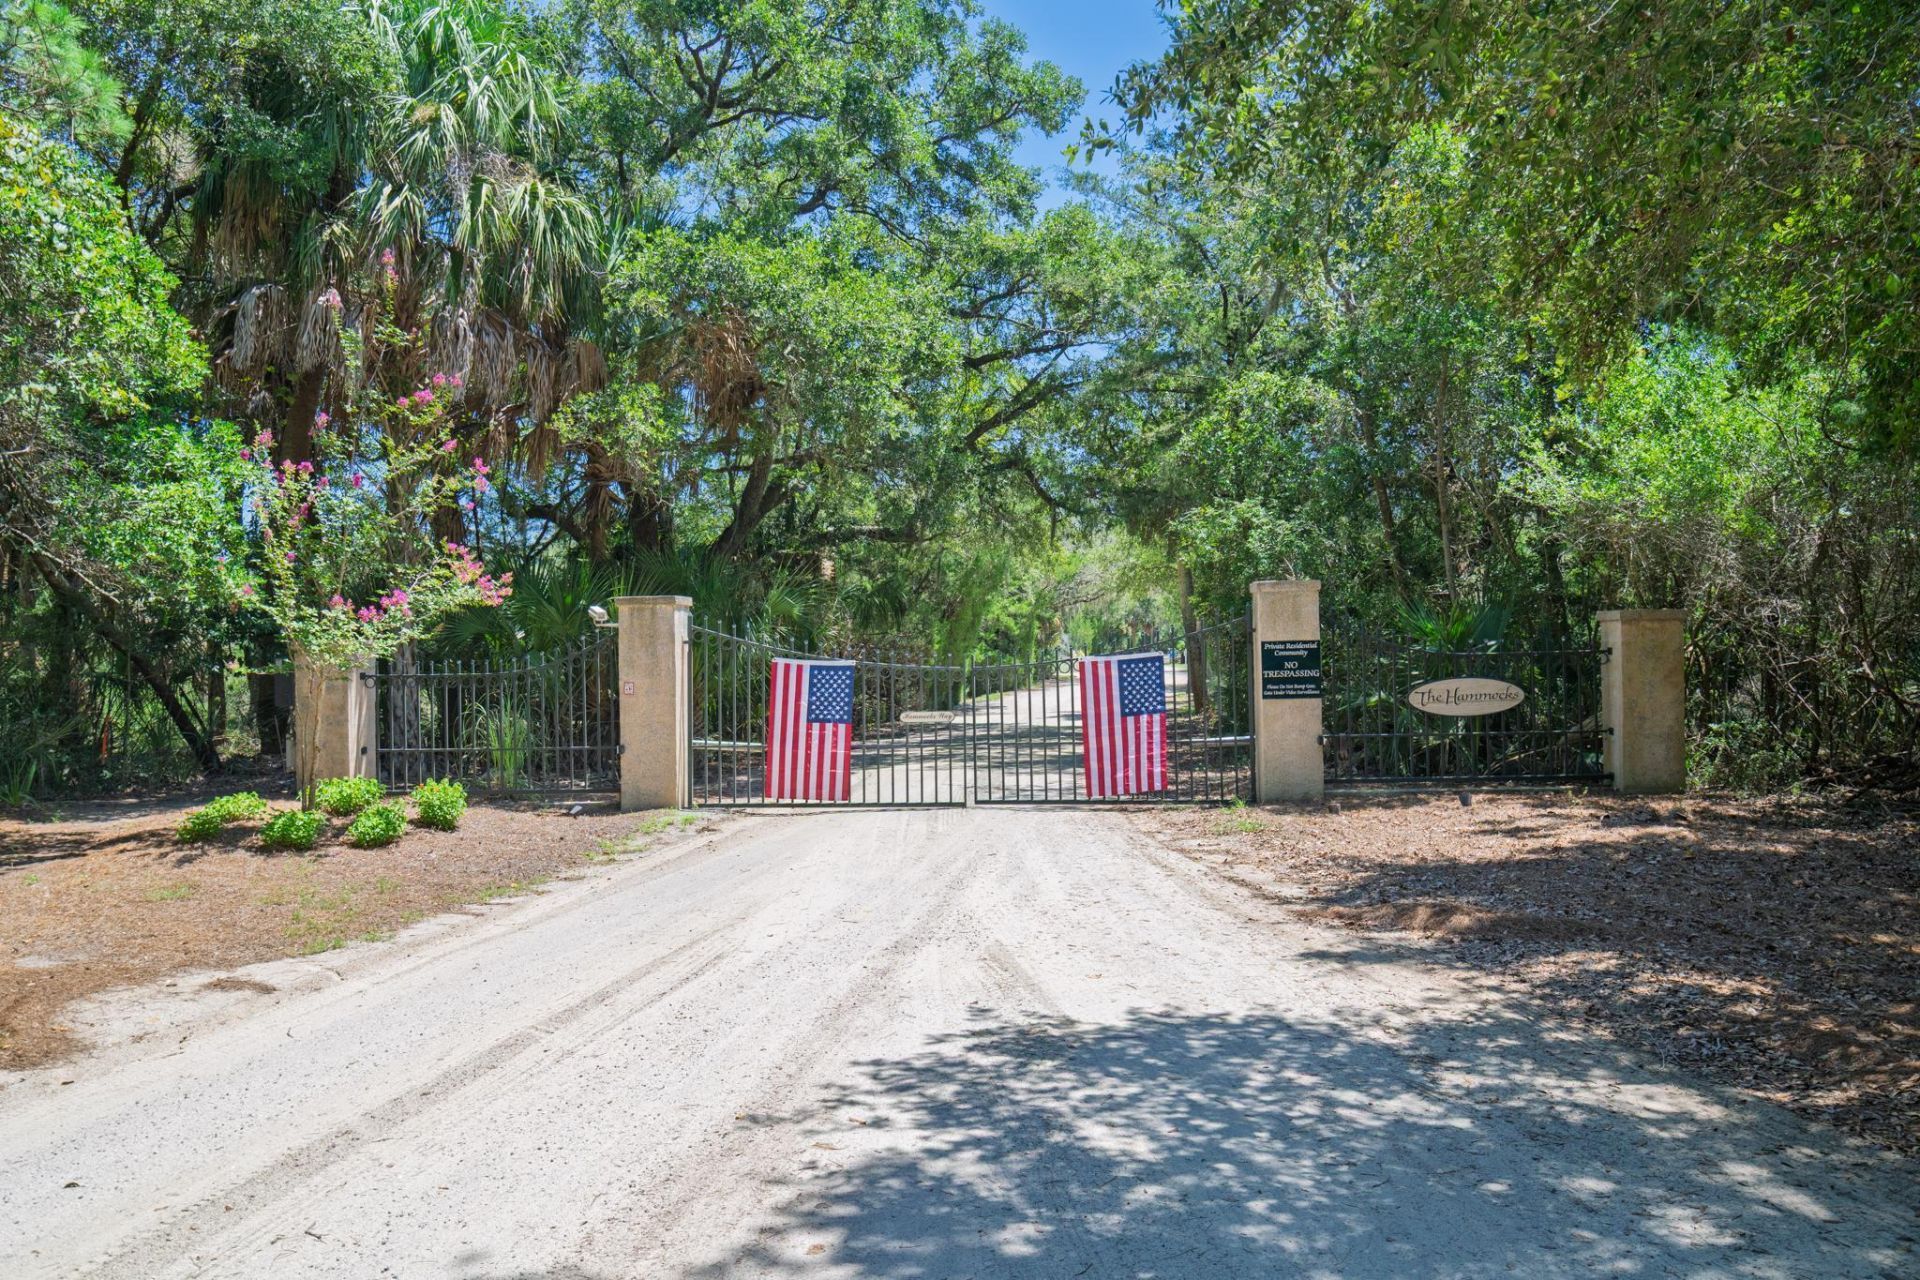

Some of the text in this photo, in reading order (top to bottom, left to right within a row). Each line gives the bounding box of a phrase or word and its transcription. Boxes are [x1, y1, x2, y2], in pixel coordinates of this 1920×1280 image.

[1284, 661, 1298, 669] NO
[1263, 669, 1320, 678] TRESPASSING
[1415, 685, 1519, 707] The Hammocks
